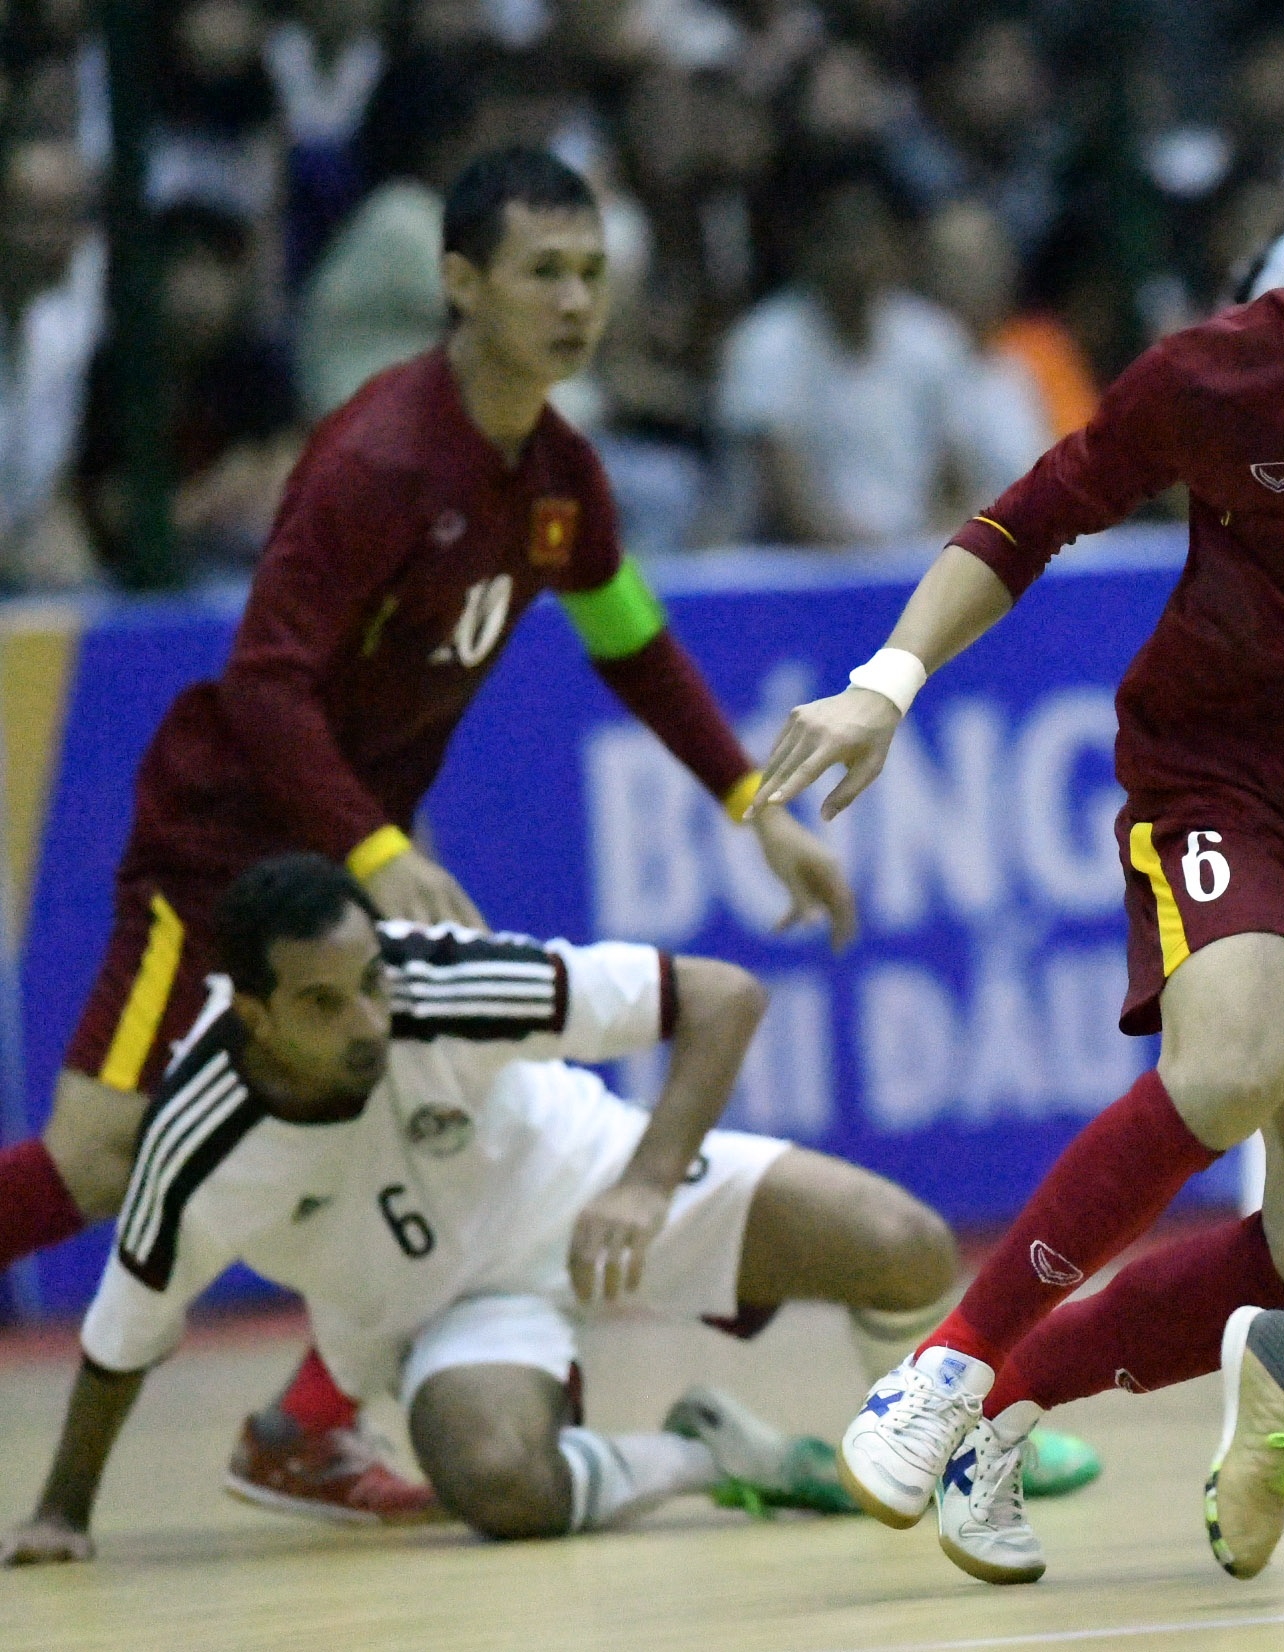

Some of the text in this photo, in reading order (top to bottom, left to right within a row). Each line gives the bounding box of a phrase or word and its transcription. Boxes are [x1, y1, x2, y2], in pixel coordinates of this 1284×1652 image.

[427, 573, 513, 668] 0
[1181, 831, 1231, 903] 6
[378, 1184, 436, 1260] 6
